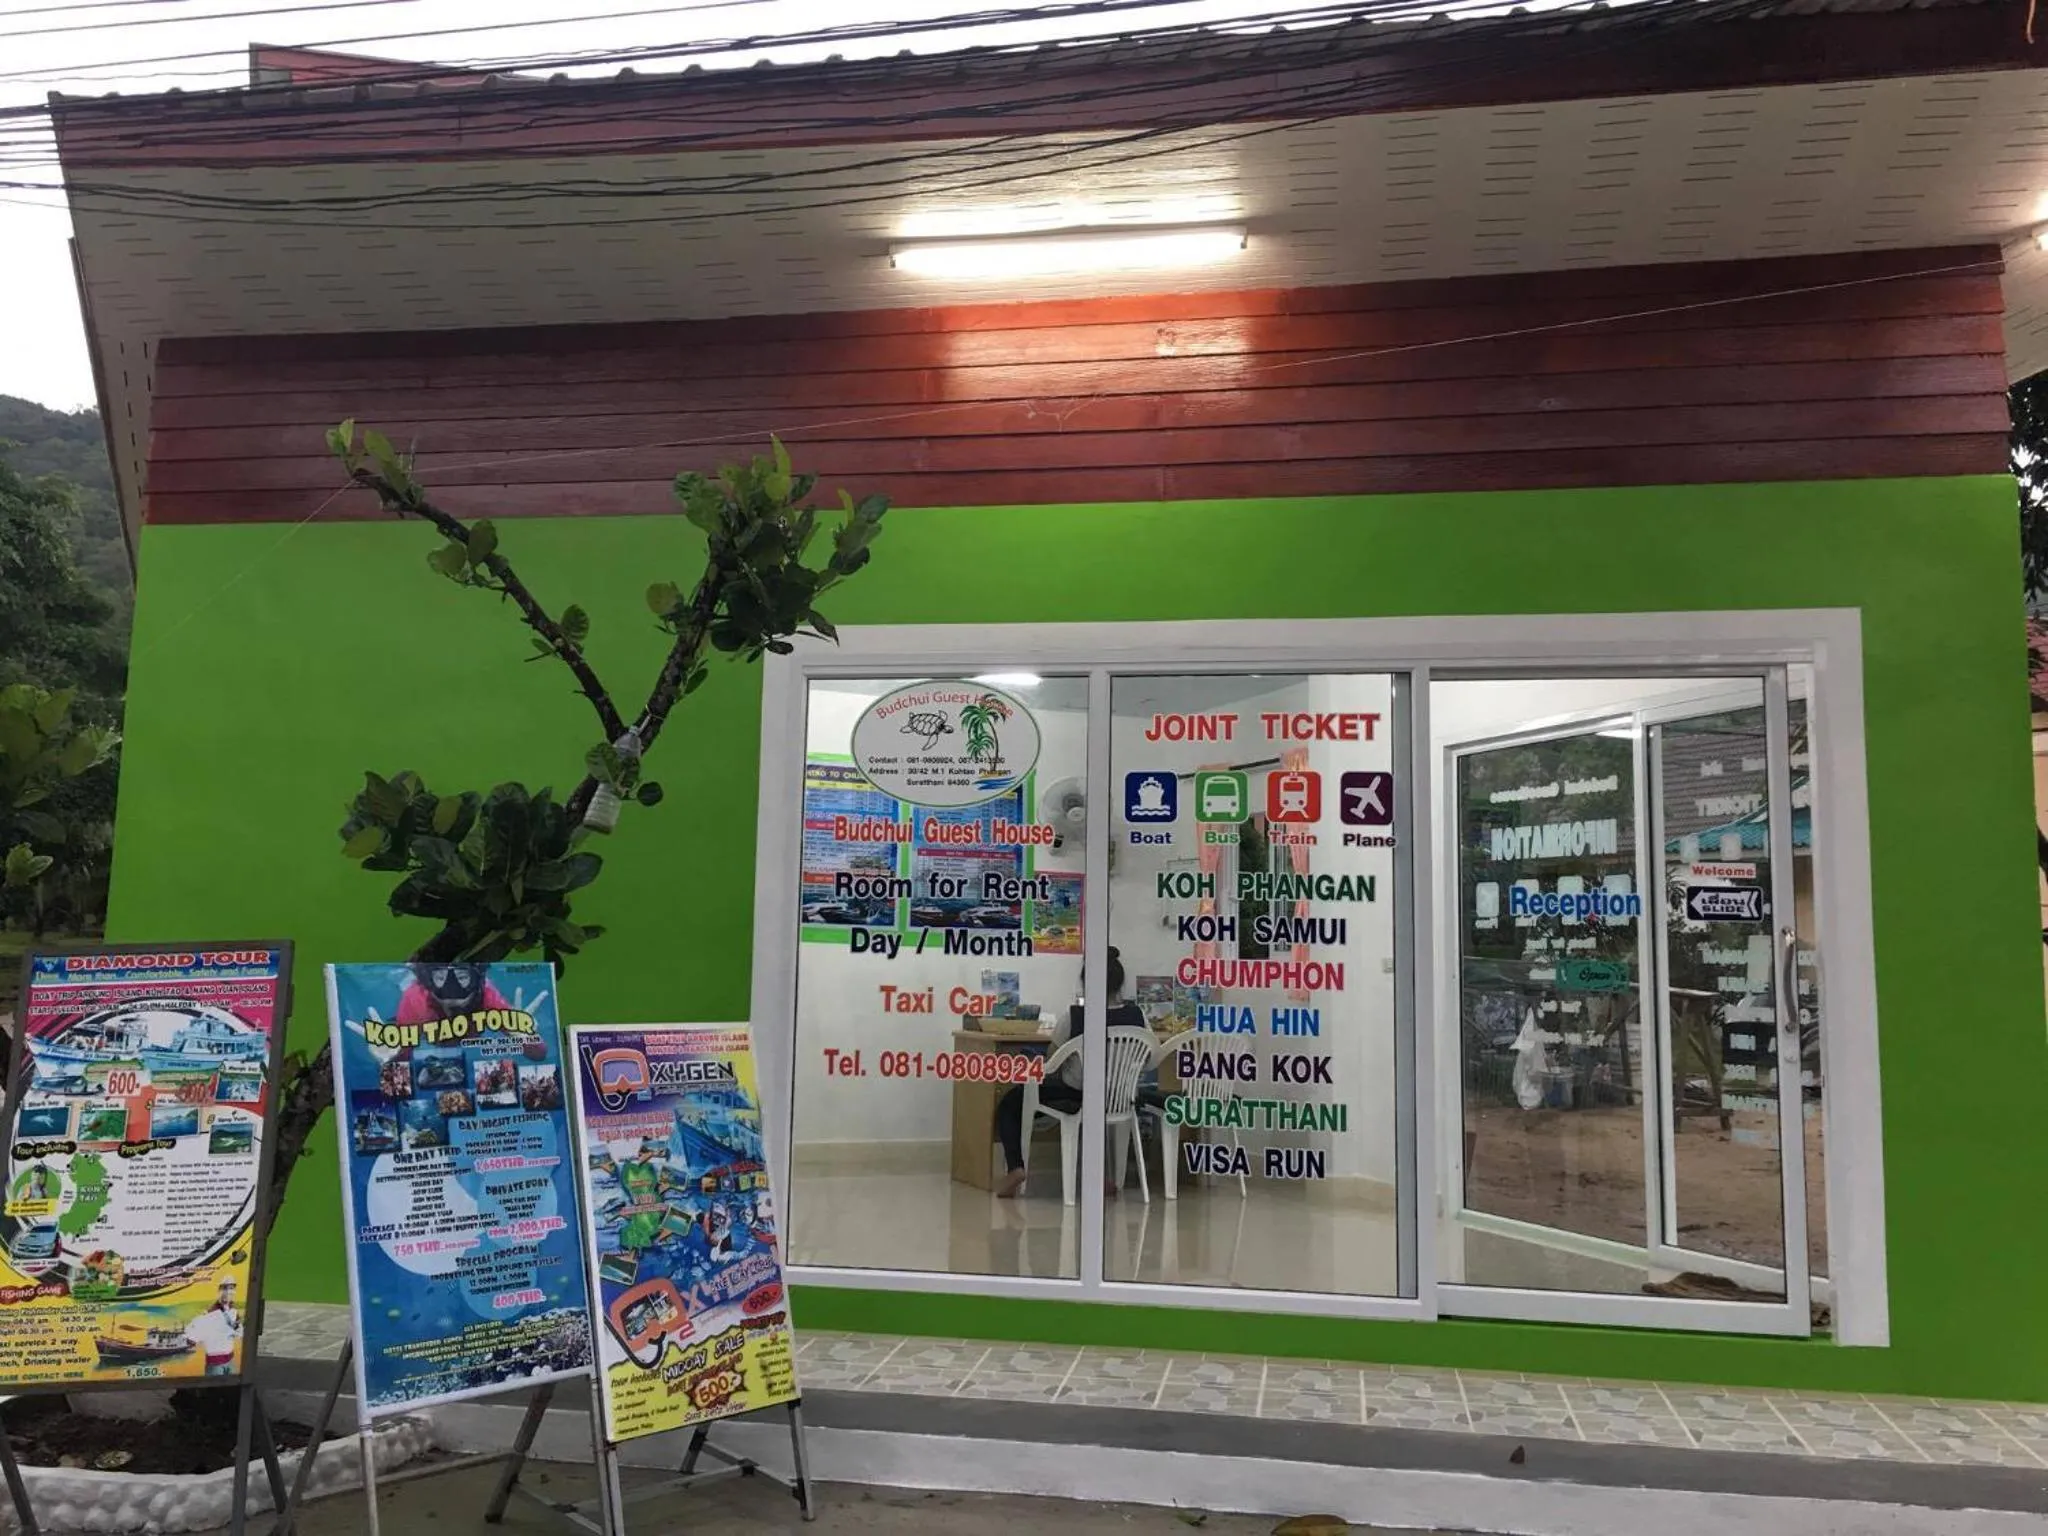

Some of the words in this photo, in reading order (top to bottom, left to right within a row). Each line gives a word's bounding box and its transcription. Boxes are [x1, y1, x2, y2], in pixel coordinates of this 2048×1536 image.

[875, 694, 930, 720] Budchui
[932, 691, 970, 704] Guest
[1145, 714, 1238, 741] JOINT
[1261, 713, 1381, 741] TICKET
[868, 756, 898, 765] Contact
[868, 767, 899, 775] Address
[834, 816, 912, 843] Budchui
[924, 818, 982, 845] Guest
[992, 819, 1055, 846] House
[1130, 831, 1171, 845] Boat
[1205, 830, 1240, 844] Bus
[1269, 831, 1317, 846] Train
[1343, 833, 1396, 848] Plane
[1692, 864, 1754, 876] Welcome
[834, 872, 912, 899] Room
[929, 872, 968, 898] for
[984, 873, 1049, 900] Rent
[1157, 873, 1216, 899] KOH
[1236, 873, 1376, 902] PHANGAN
[1509, 886, 1641, 919] Reception
[1702, 905, 1745, 913] SLIDE
[851, 927, 901, 959] Day
[917, 928, 929, 955] /
[944, 927, 1033, 957] Month
[1178, 915, 1236, 942] KOH
[1255, 917, 1347, 945] SAMUI
[66, 953, 195, 972] DIAMOND
[201, 951, 270, 966] TOUR
[1177, 958, 1344, 991] CHUMPHON
[879, 984, 934, 1014] Taxi
[949, 986, 997, 1016] Car
[364, 1020, 420, 1048] KOH
[423, 1015, 468, 1043] TAO
[472, 1010, 536, 1035] TOUR
[1197, 1005, 1257, 1034] HUA
[1271, 1008, 1320, 1037] HIN
[824, 1049, 866, 1077] Tel.
[880, 1050, 1045, 1085] 081-0808924
[1178, 1051, 1256, 1082] BANG
[1272, 1055, 1332, 1084] KOK
[1165, 1096, 1347, 1132] SURATTHANI
[393, 1151, 414, 1164] ONE
[415, 1150, 436, 1161] DAY
[1186, 1143, 1250, 1176] VISA
[1265, 1148, 1325, 1179] RUN
[486, 1180, 524, 1195] PRIVATE
[526, 1178, 549, 1188] BOAT
[394, 1244, 414, 1256] 750
[456, 1253, 491, 1267] SPECIAL
[494, 1244, 538, 1259] PROGRAM
[0, 1288, 35, 1300] FISHING
[37, 1286, 62, 1296] GAME
[14, 1339, 47, 1347] service
[51, 1338, 57, 1346] 2
[714, 1332, 745, 1360] SALE
[24, 1357, 62, 1366] Drinking
[65, 1356, 92, 1365] water
[22, 1372, 59, 1381] CONTACT
